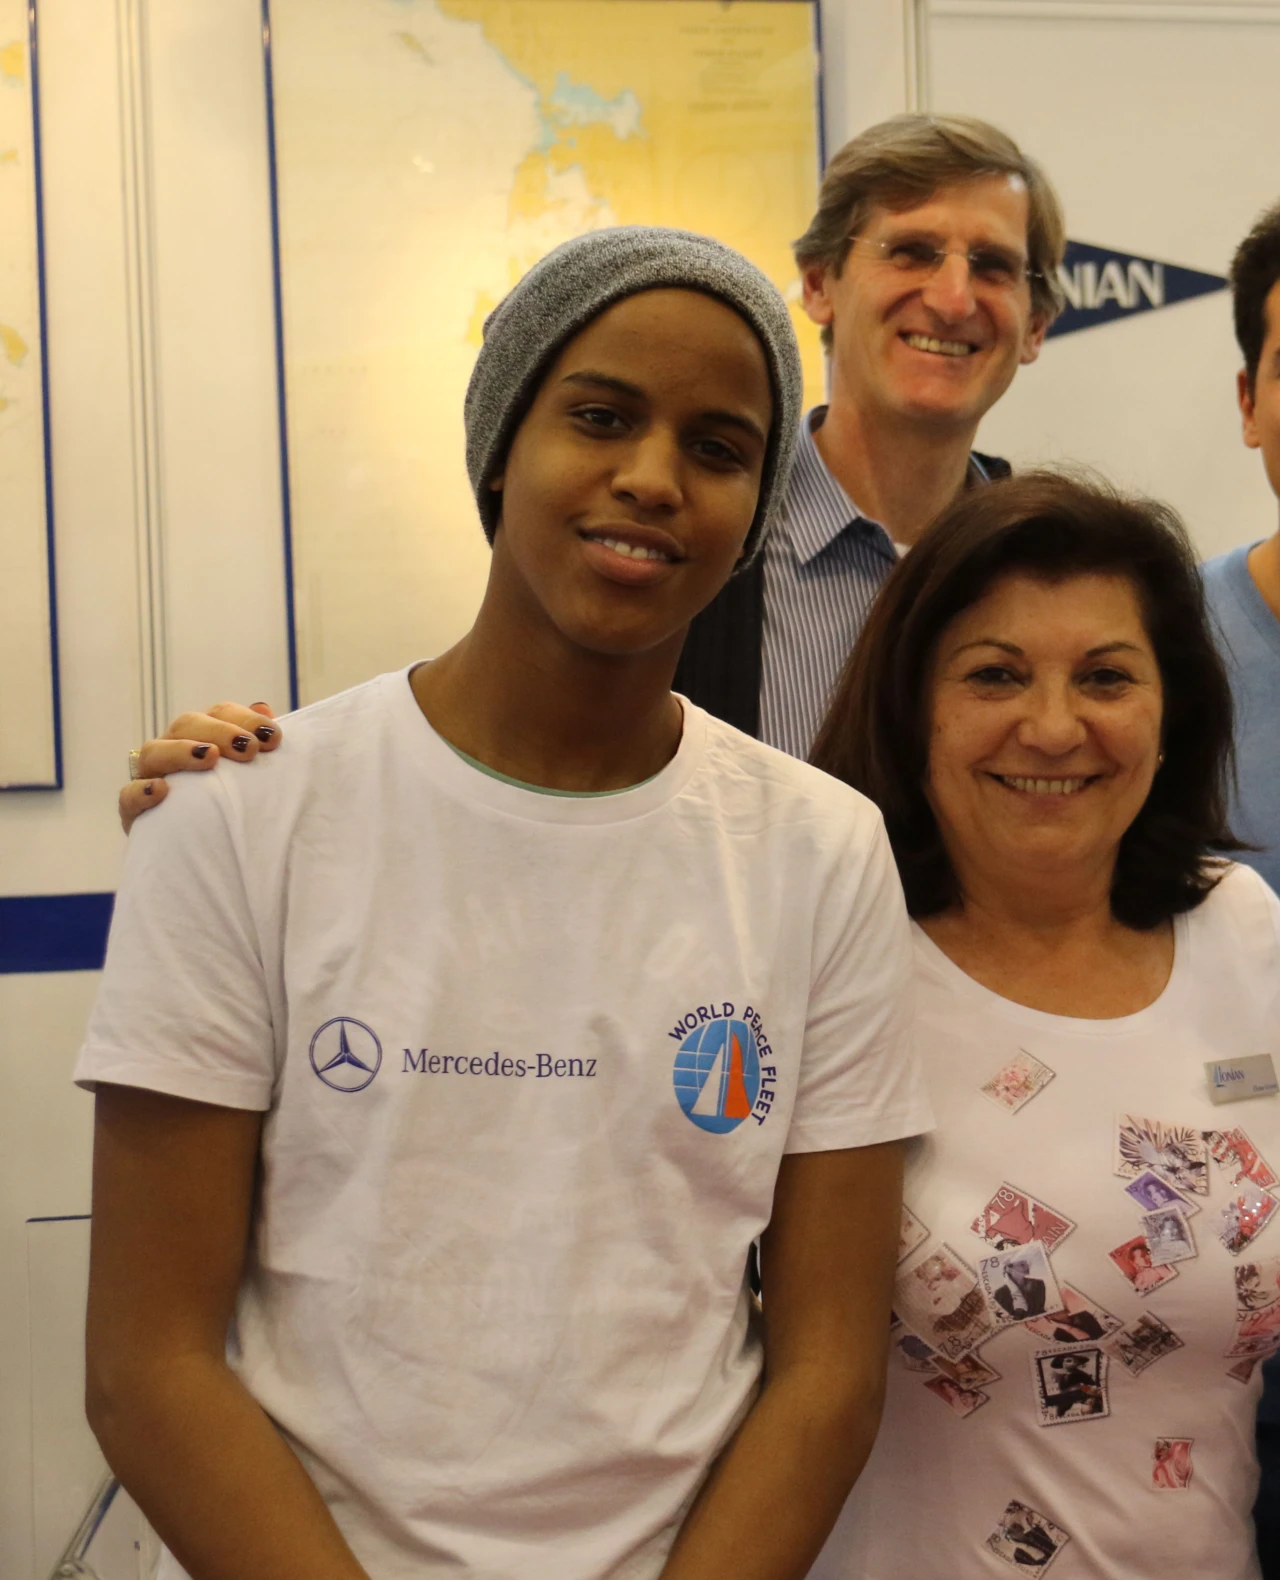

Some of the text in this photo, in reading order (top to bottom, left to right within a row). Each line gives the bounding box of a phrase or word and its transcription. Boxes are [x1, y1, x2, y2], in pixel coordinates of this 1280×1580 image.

[401, 1048, 598, 1078] Mercedes-Benz
[668, 1002, 777, 1126] WORLD PEACE FLEET
[991, 1189, 1015, 1209] 78
[980, 1257, 999, 1270] 78
